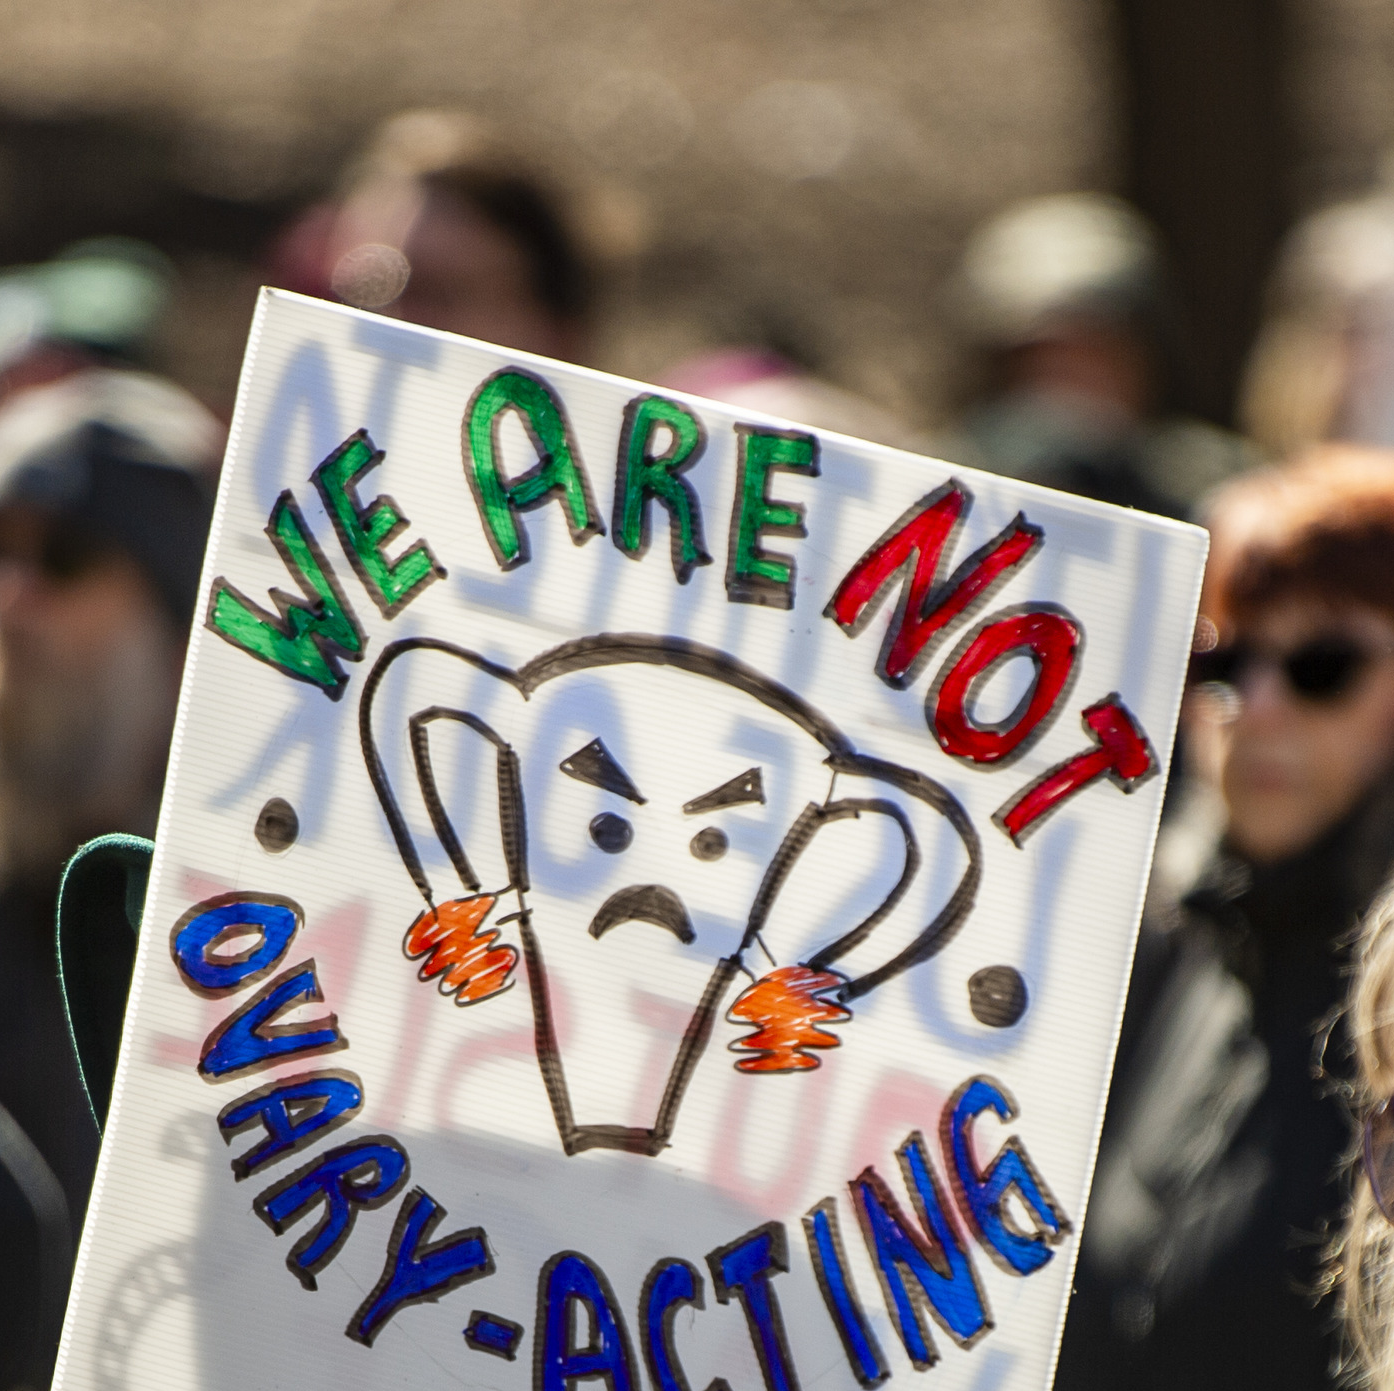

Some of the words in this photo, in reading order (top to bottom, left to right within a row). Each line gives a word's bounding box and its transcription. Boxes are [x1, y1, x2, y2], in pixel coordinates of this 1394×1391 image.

[204, 427, 449, 702] WE
[461, 364, 821, 610] ARE
[823, 476, 1161, 850] NOT
